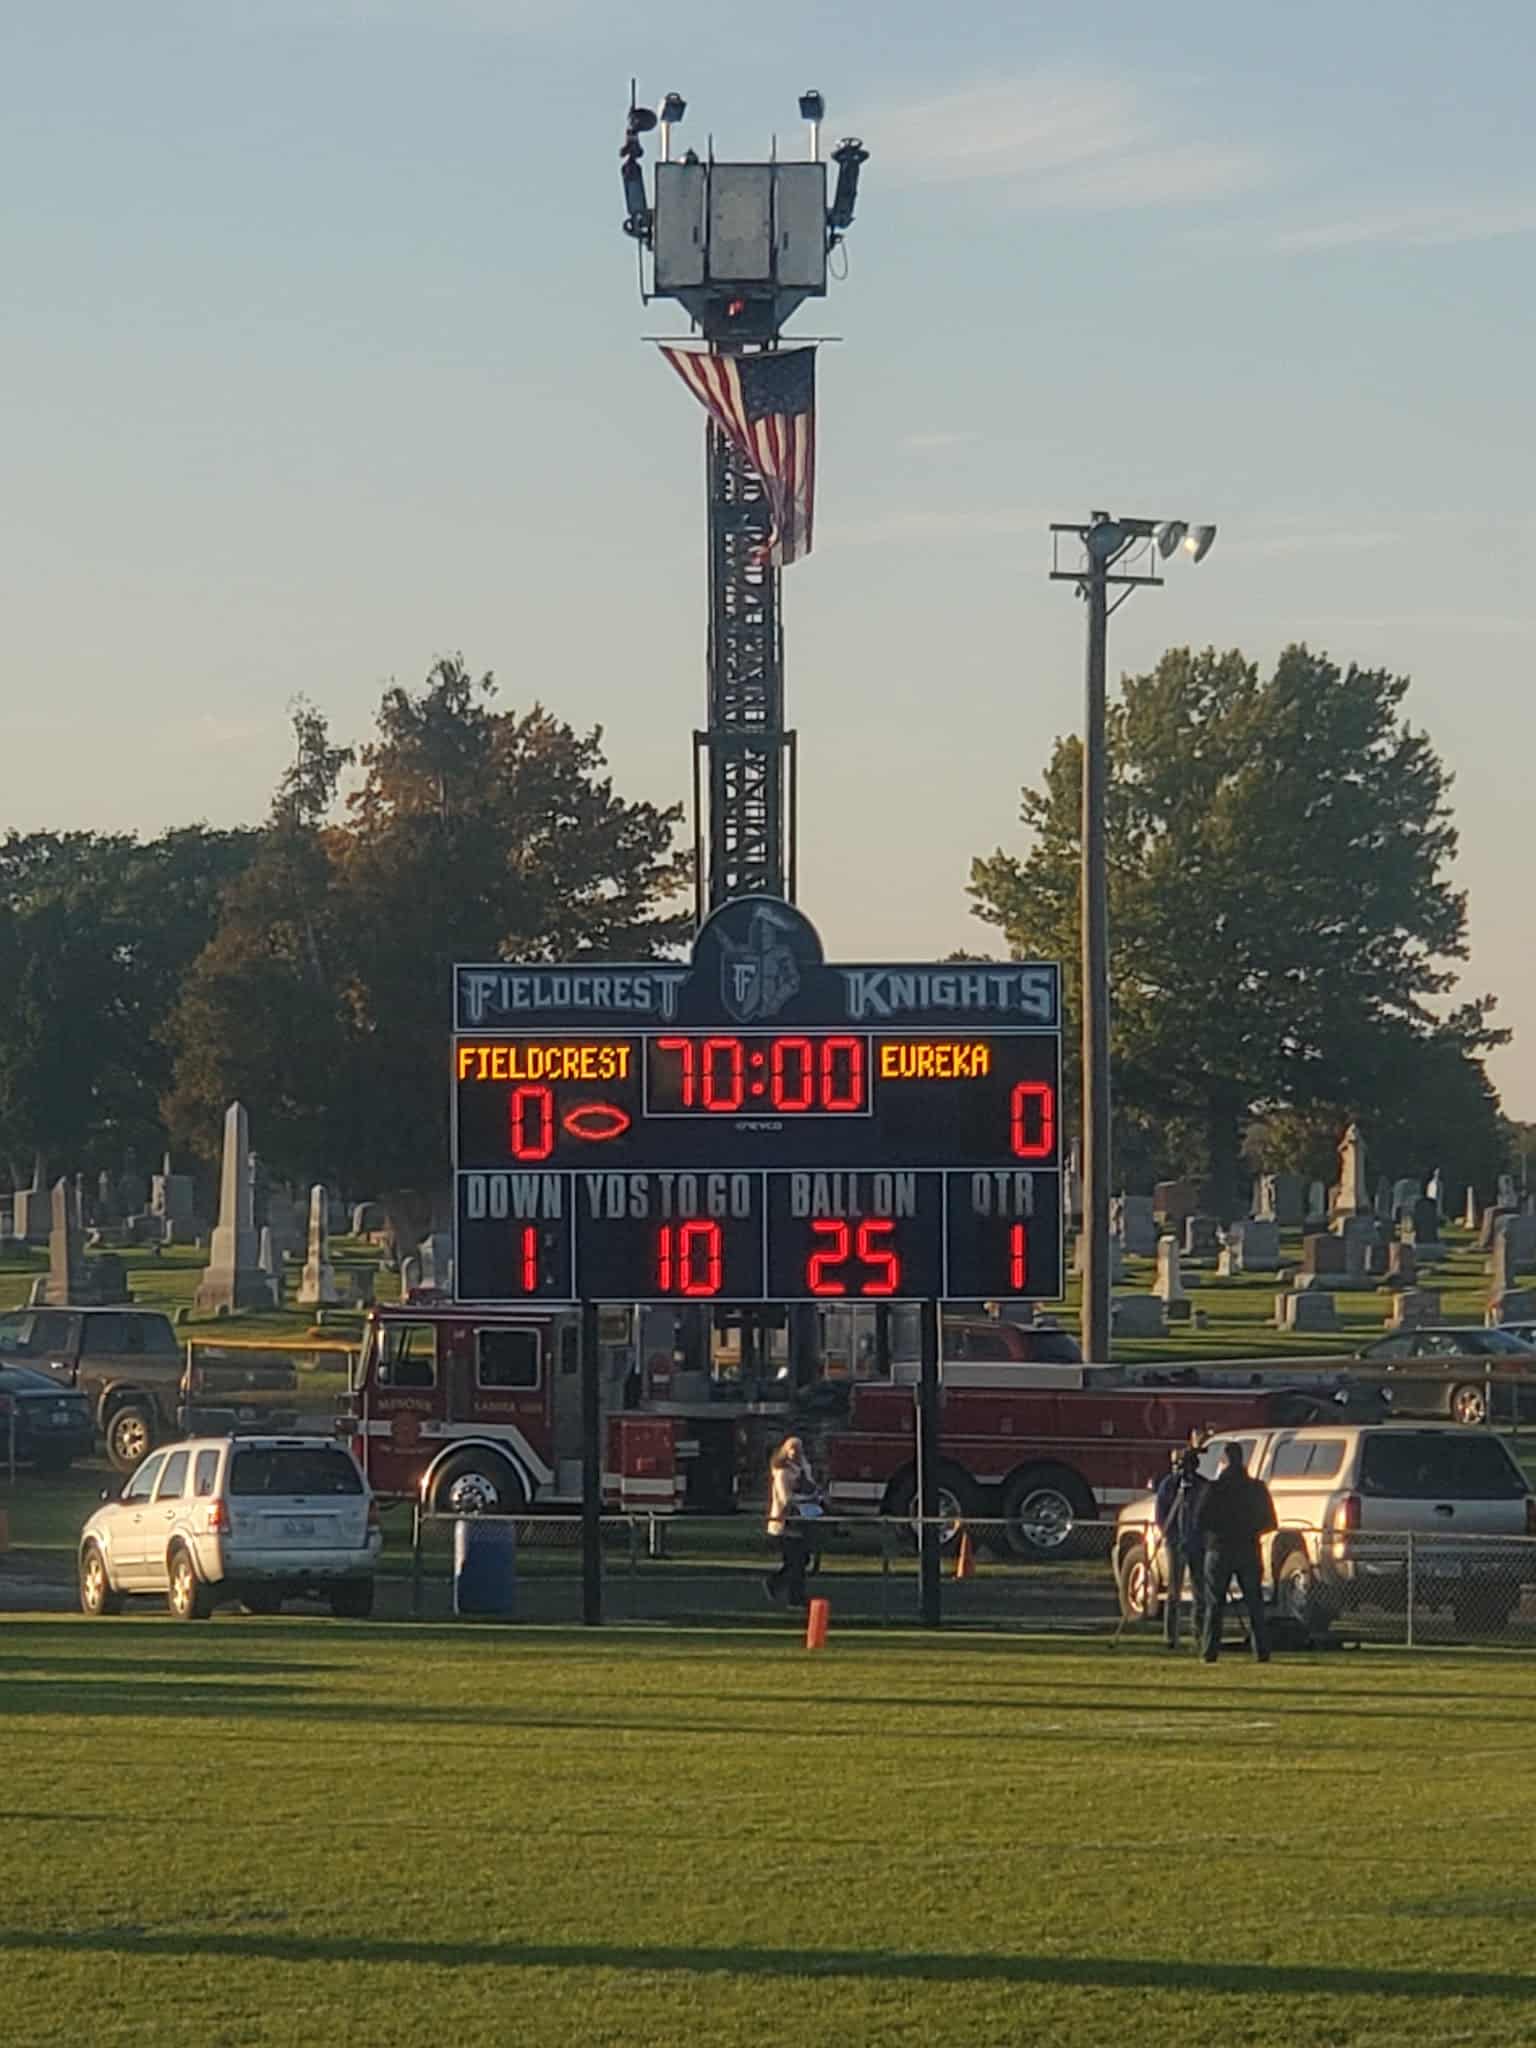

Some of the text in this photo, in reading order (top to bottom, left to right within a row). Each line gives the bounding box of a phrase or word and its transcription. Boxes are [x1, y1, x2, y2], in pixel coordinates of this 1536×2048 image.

[463, 972, 690, 1023] FIELDCREST
[843, 970, 1054, 1020] KNIGHTS
[458, 1045, 631, 1082] FIELDCREST
[656, 1037, 866, 1112] 70:00
[880, 1045, 991, 1078] EUREKA
[509, 1085, 554, 1161] 0
[1010, 1081, 1055, 1158] 0
[467, 1175, 563, 1219] DOWN
[586, 1174, 751, 1219] YDS TO GO
[791, 1174, 916, 1217] BALL ON
[972, 1172, 1035, 1216] QTR
[523, 1227, 536, 1292] 1
[656, 1219, 724, 1296] 10
[805, 1219, 901, 1296] 25
[1011, 1224, 1024, 1290] 1
